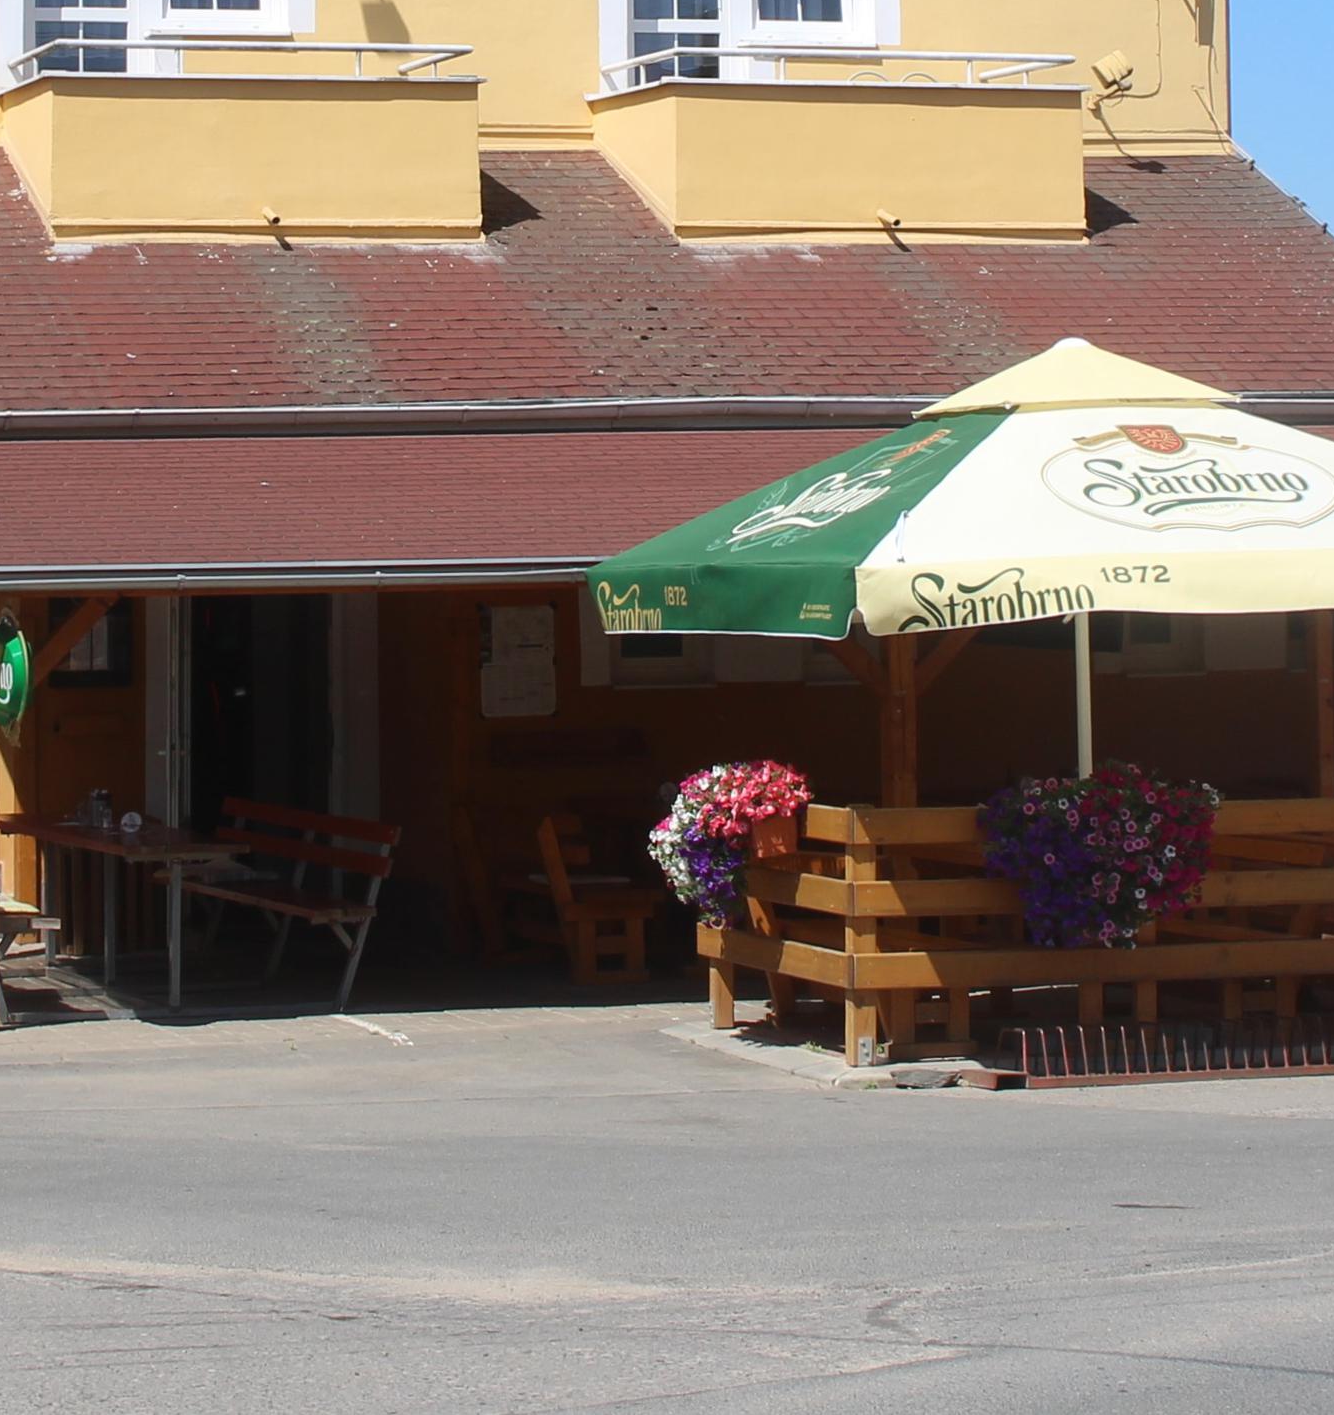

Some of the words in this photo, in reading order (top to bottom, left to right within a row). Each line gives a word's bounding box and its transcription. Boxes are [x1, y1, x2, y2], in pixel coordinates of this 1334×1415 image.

[1083, 458, 1309, 516] Starobrno
[597, 581, 662, 631] Starobrno
[664, 585, 688, 607] 1872
[898, 567, 1095, 632] Starobrno
[1100, 564, 1171, 584] 1872
